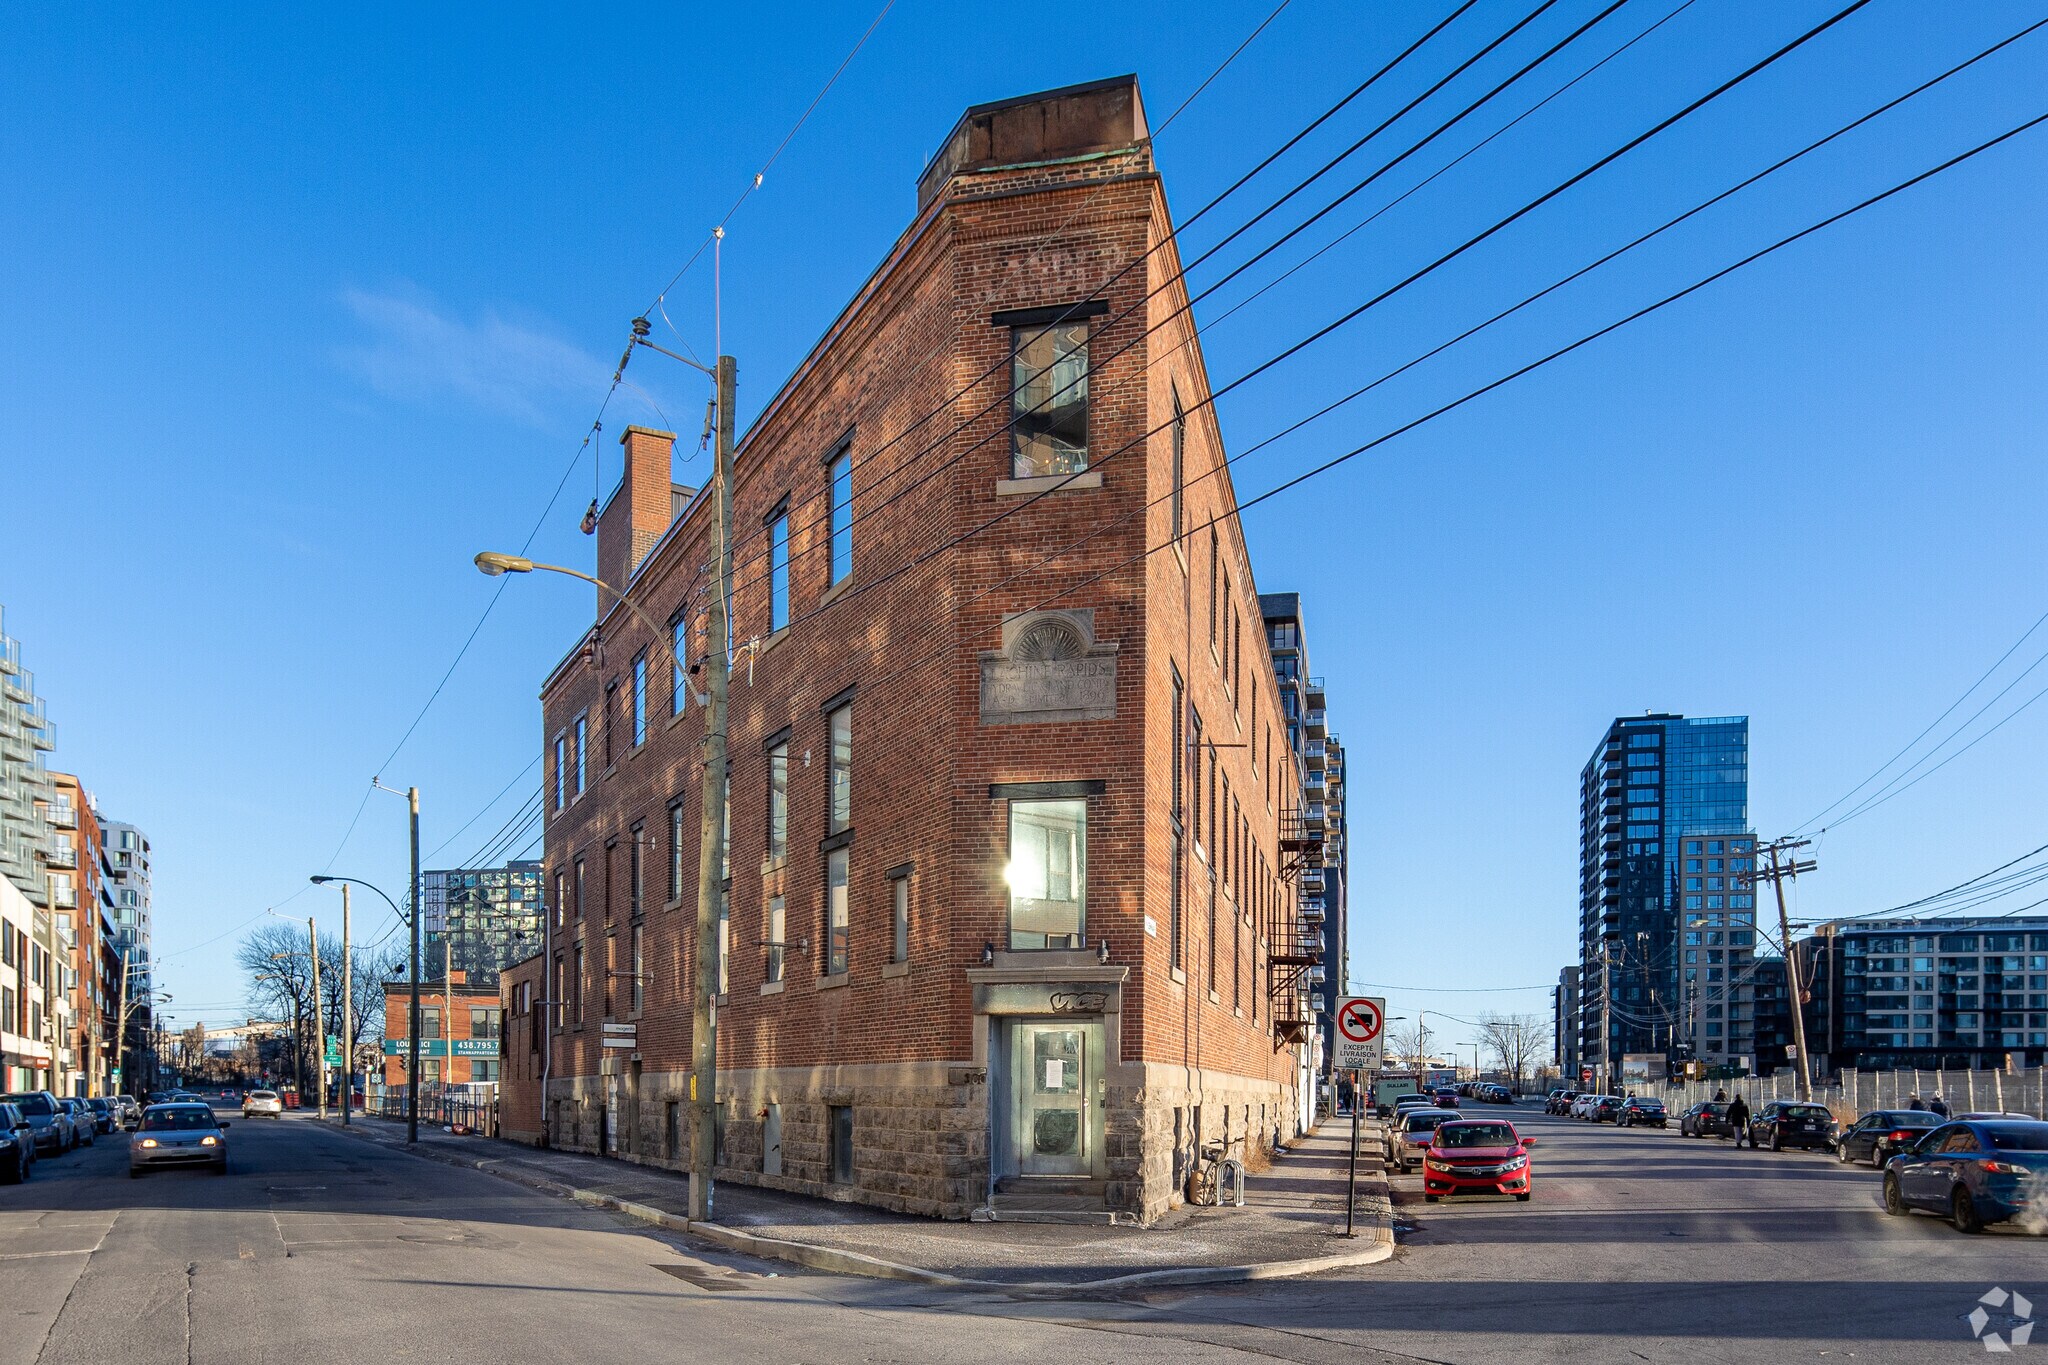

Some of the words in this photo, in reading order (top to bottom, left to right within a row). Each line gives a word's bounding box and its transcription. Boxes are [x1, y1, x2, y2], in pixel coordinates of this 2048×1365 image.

[991, 664, 1053, 681] LACHINE
[1056, 662, 1107, 679] RAPIDS
[1050, 992, 1109, 1012] VICE
[396, 1040, 412, 1048] LOU
[458, 1041, 499, 1049] 438.795.7
[1340, 1050, 1377, 1058] LIVRAISON
